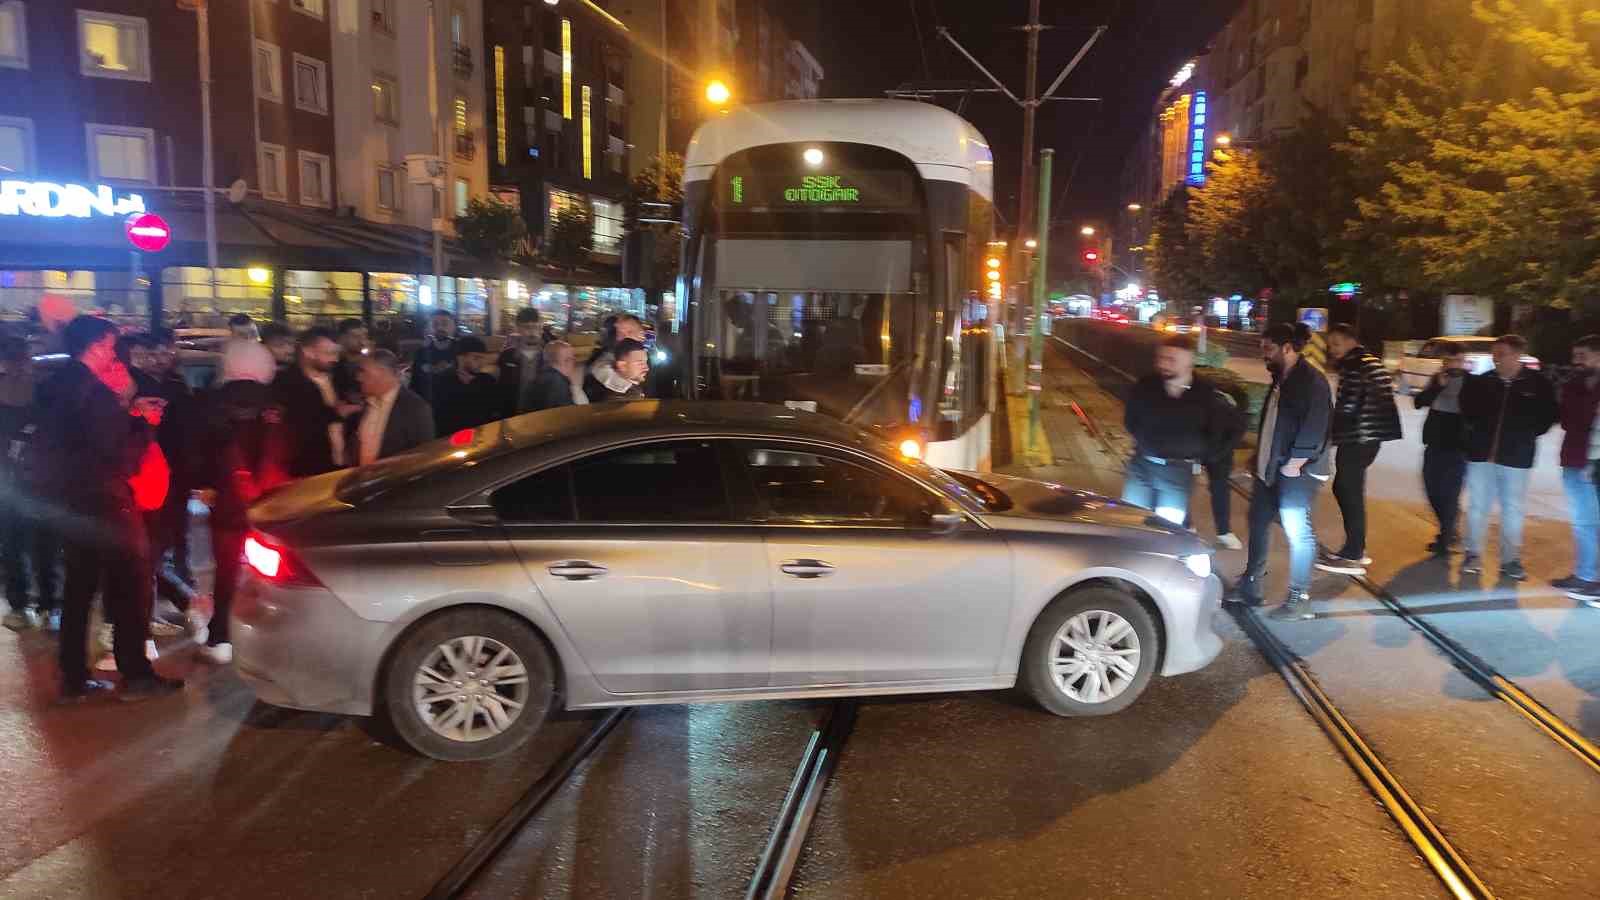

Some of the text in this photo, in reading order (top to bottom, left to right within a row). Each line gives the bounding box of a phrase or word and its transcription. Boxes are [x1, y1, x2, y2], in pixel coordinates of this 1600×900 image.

[731, 175, 743, 202] 1
[802, 175, 841, 188] SSK
[783, 188, 860, 202] OTOGAR
